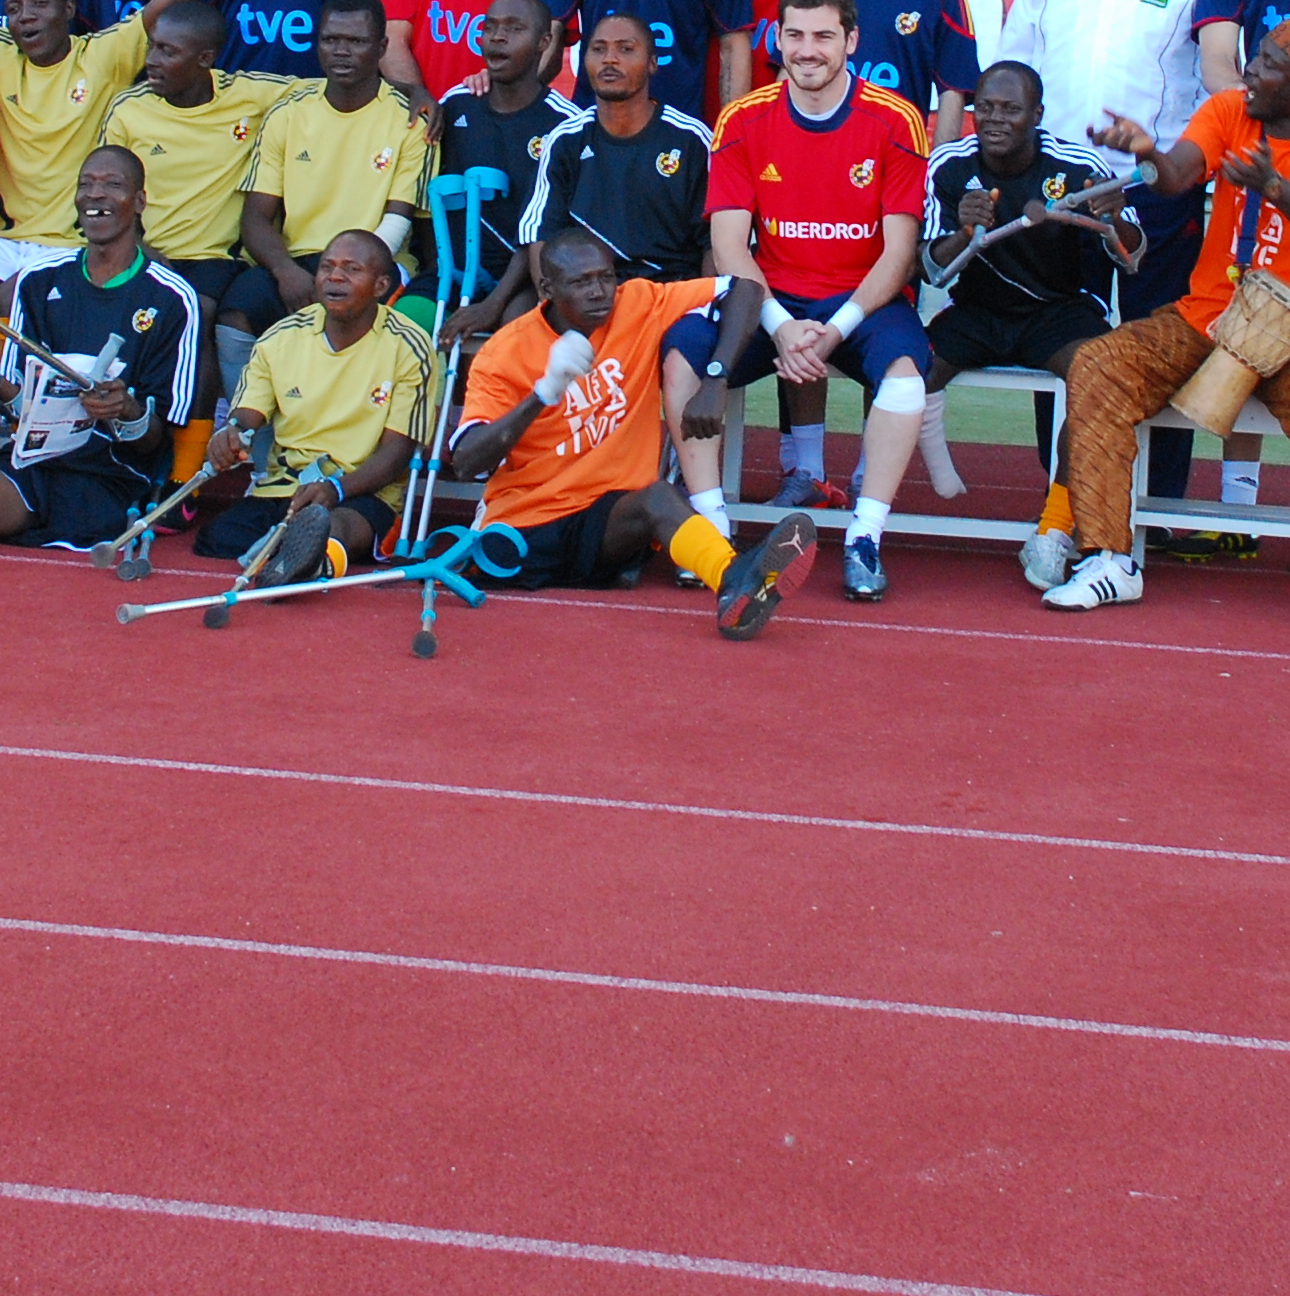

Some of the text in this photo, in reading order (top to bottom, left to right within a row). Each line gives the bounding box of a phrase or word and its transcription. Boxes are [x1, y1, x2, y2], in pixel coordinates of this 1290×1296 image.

[236, 3, 313, 52] tve
[427, 0, 485, 56] tve
[849, 60, 900, 89] ve
